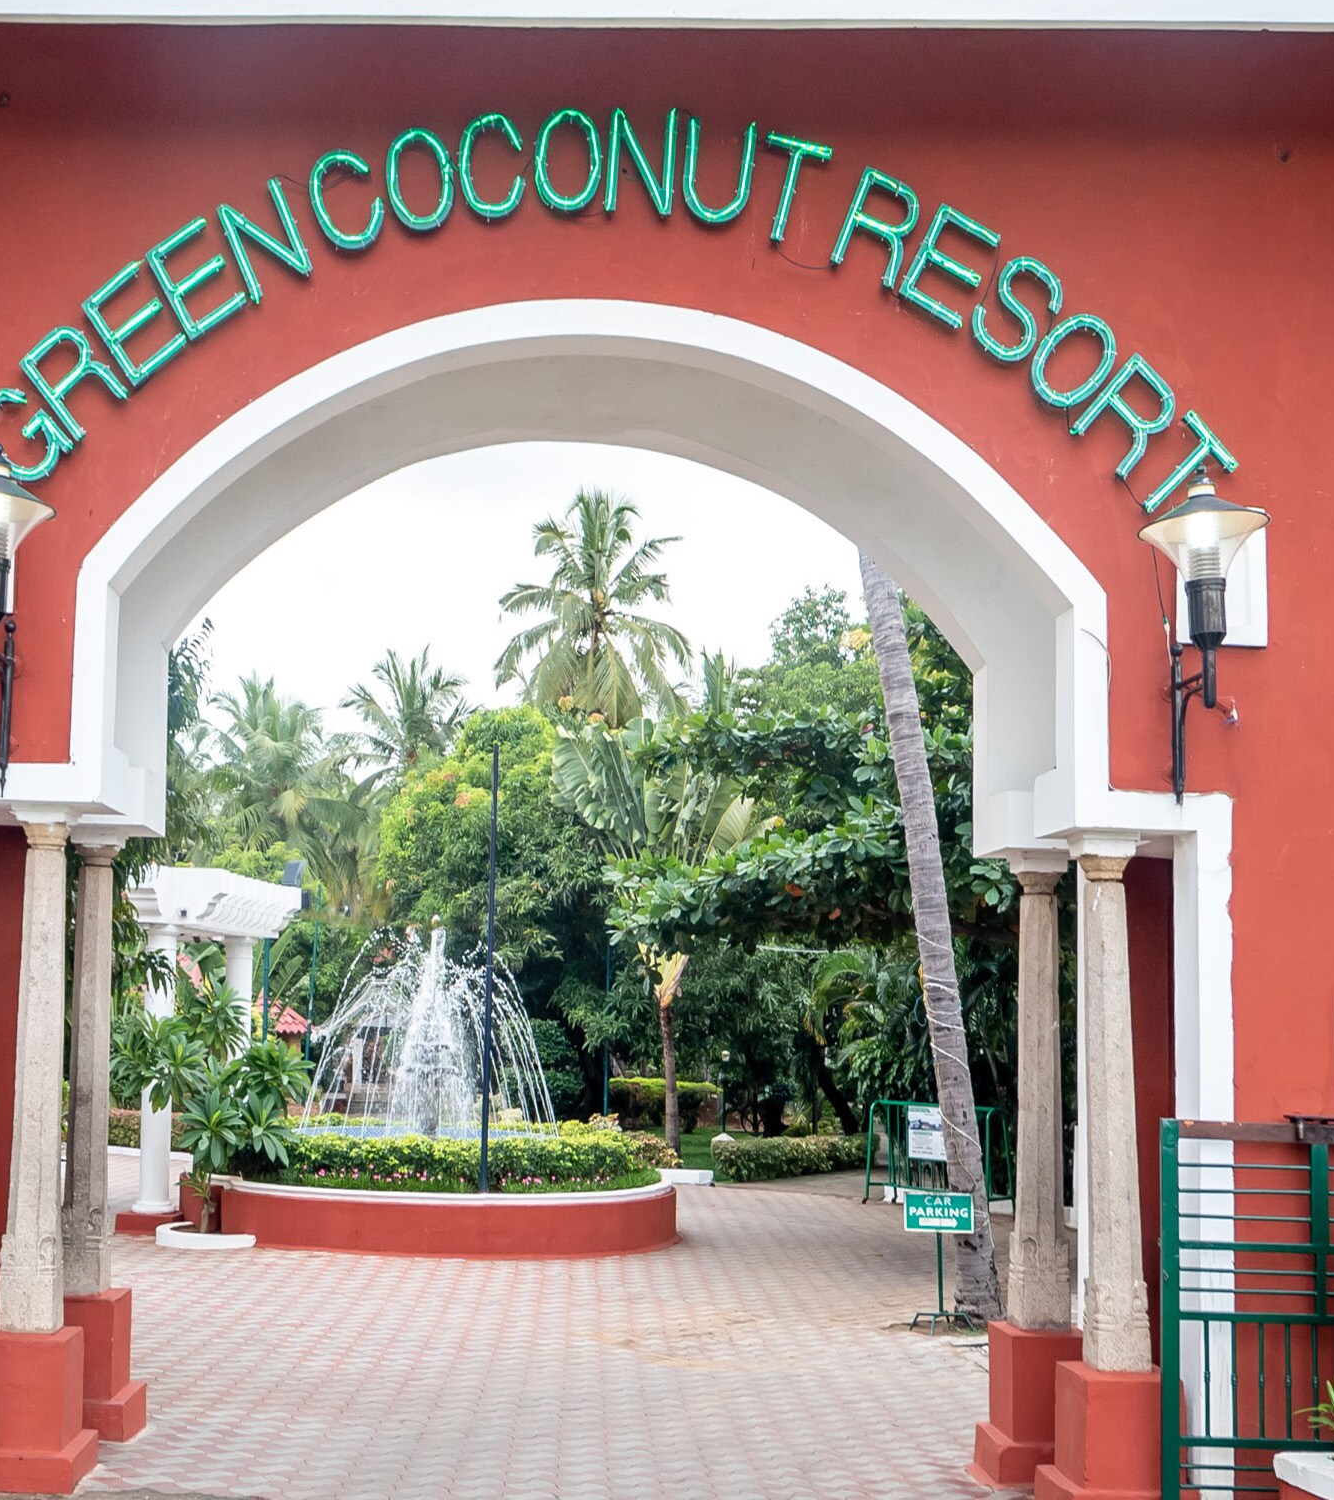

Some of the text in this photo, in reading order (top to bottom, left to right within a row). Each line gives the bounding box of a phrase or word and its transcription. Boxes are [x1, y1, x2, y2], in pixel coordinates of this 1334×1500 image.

[309, 107, 833, 252] COCONUT
[828, 166, 1239, 515] RESORT
[924, 1196, 952, 1206] CAR
[909, 1206, 969, 1218] PARKING
